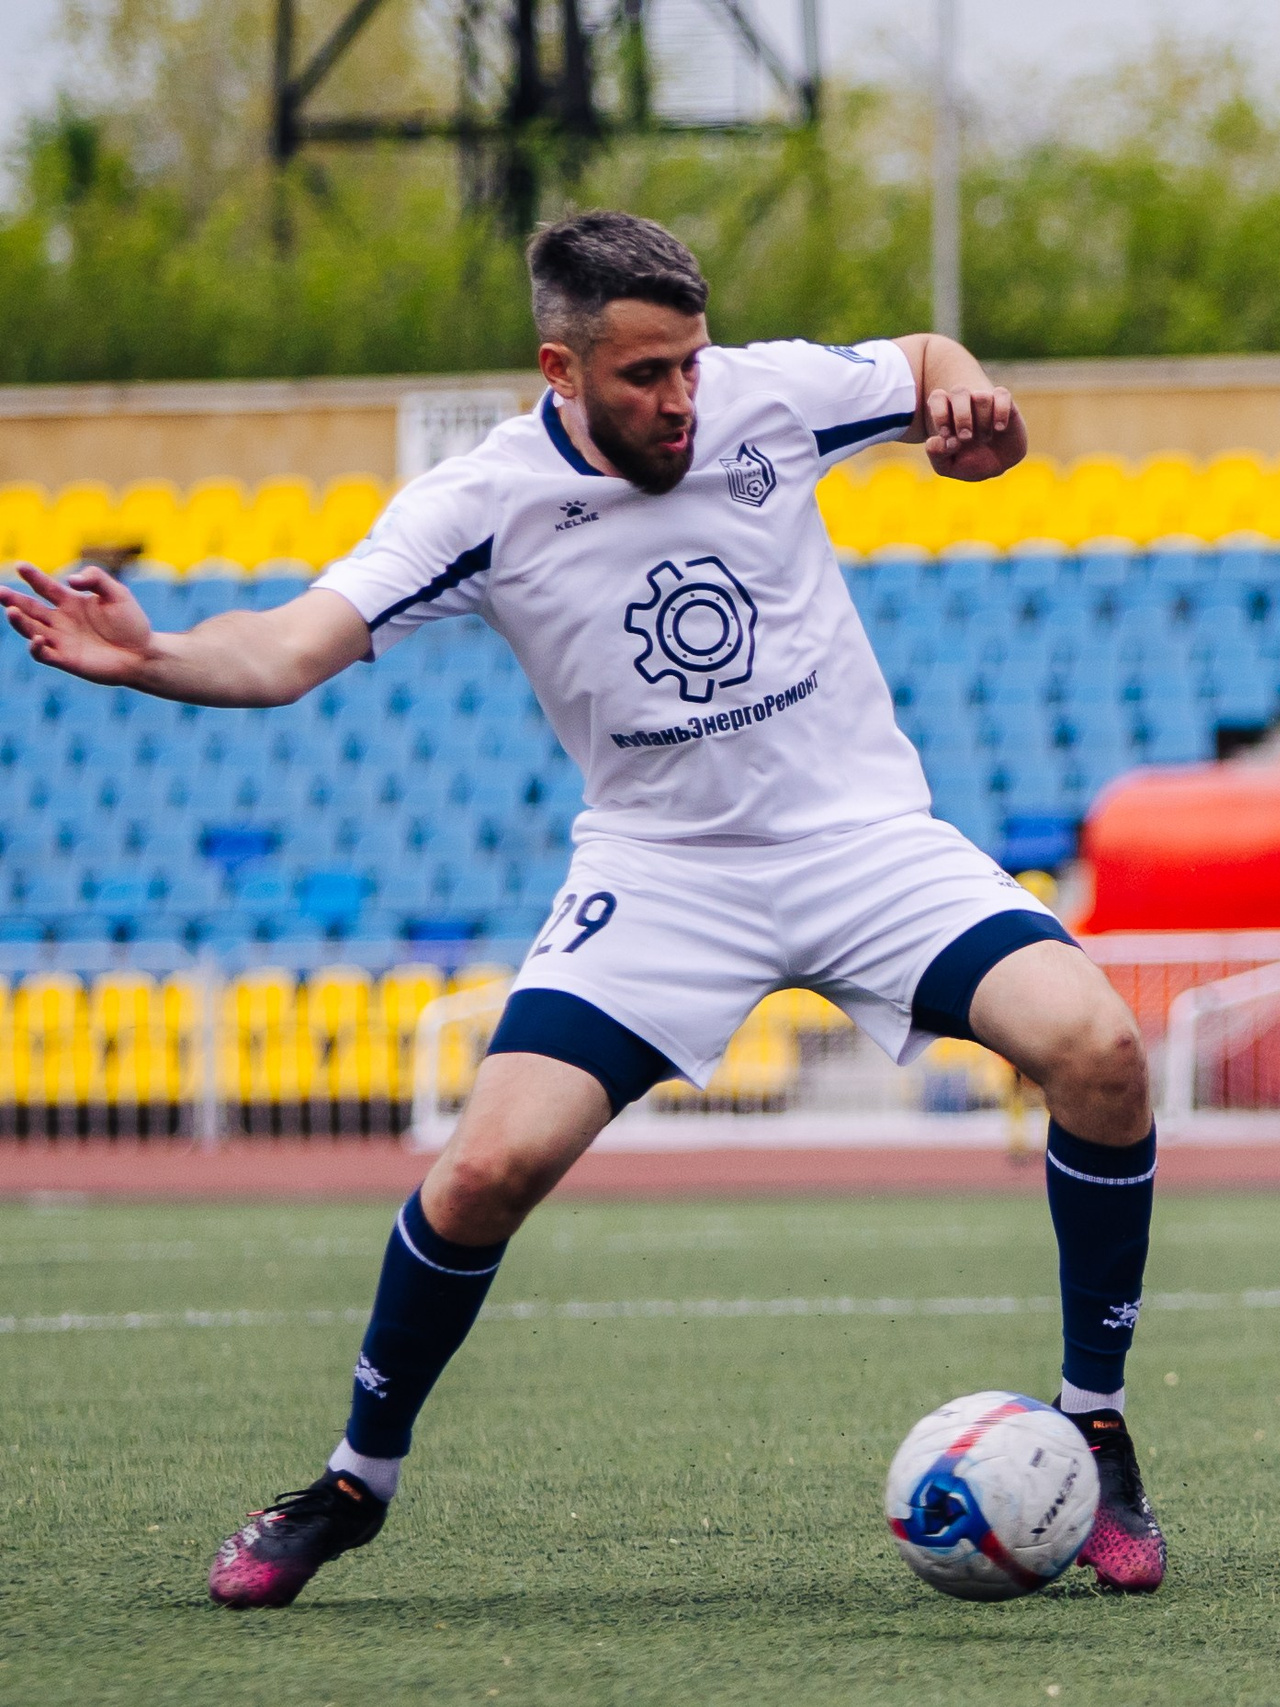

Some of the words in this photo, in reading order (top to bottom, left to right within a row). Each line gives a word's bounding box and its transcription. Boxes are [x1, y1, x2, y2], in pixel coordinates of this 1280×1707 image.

[554, 511, 600, 532] KELME
[610, 670, 819, 749] КубаньЭнергоРемонт
[530, 890, 618, 959] 29
